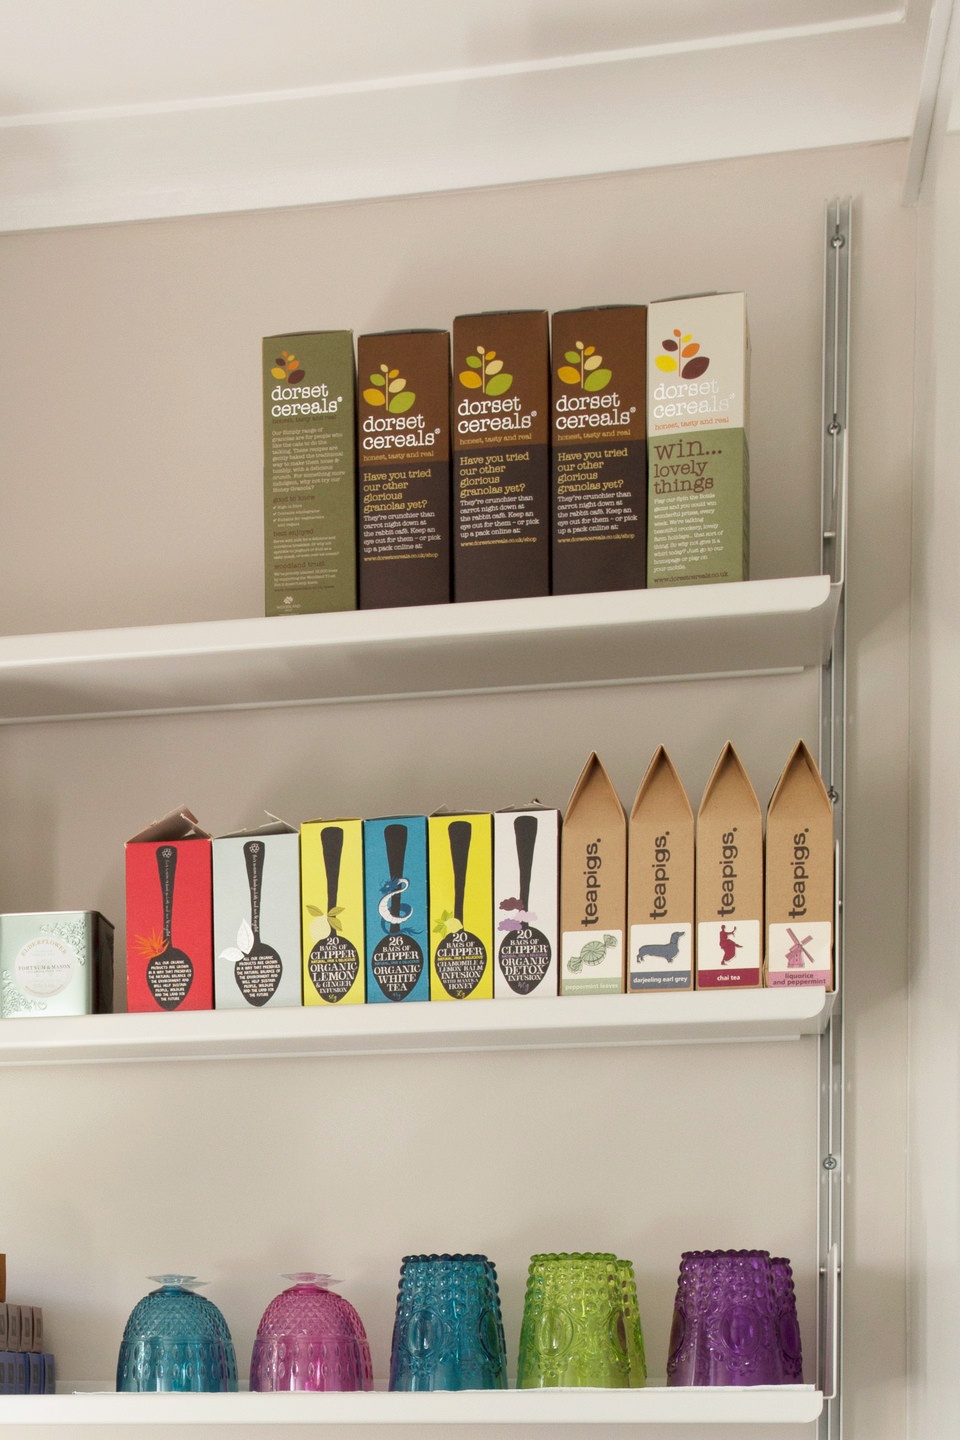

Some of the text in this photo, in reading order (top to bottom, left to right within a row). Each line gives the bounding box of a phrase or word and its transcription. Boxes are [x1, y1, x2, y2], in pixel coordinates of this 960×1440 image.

[271, 384, 328, 400] dorset
[654, 380, 719, 401] dorset
[458, 396, 521, 416] dorset
[556, 392, 620, 412] dorset
[362, 414, 425, 432] dorset
[558, 448, 628, 461] Have you tried
[654, 439, 722, 460] win...
[460, 452, 529, 465] Have you tried
[460, 465, 506, 476] our other
[558, 461, 604, 472] our other
[654, 460, 708, 478] lovely
[364, 470, 431, 481] Have you tried
[558, 472, 598, 484] glorious
[364, 482, 408, 492] our other
[460, 476, 499, 488] glorious
[558, 480, 623, 494] granolas yet?
[654, 477, 714, 495] things
[460, 484, 525, 498] granolas yet?
[364, 492, 402, 503] glorious
[364, 500, 427, 514] granolas yet?
[650, 831, 670, 920] teapigs.
[717, 827, 738, 917] teapigs.
[788, 828, 809, 918] teapigs.
[581, 838, 602, 926] teapigs.
[452, 932, 468, 942] 20
[516, 928, 532, 940] 20
[326, 937, 340, 946] 20
[389, 936, 404, 946] 26
[437, 946, 484, 958] CLIPPER
[501, 944, 547, 954] CLIPPER
[310, 950, 355, 960] CLIPPER
[374, 951, 419, 962] CLIPPER
[502, 956, 549, 966] ORGANIC
[310, 962, 358, 972] ORGANIC
[374, 964, 421, 975] ORGANIC
[504, 964, 545, 976] DETOX
[313, 971, 355, 982] LEMON
[378, 974, 417, 984] WHITE
[441, 971, 481, 980] INFUSION
[508, 974, 542, 982] INFUSION
[633, 977, 662, 985] darjeeling
[676, 976, 688, 984] grey
[784, 972, 814, 980] liquorice
[322, 980, 351, 988] GINGER
[386, 983, 408, 992] TEA
[448, 982, 473, 990] HONEY
[787, 978, 826, 987] peppermint
